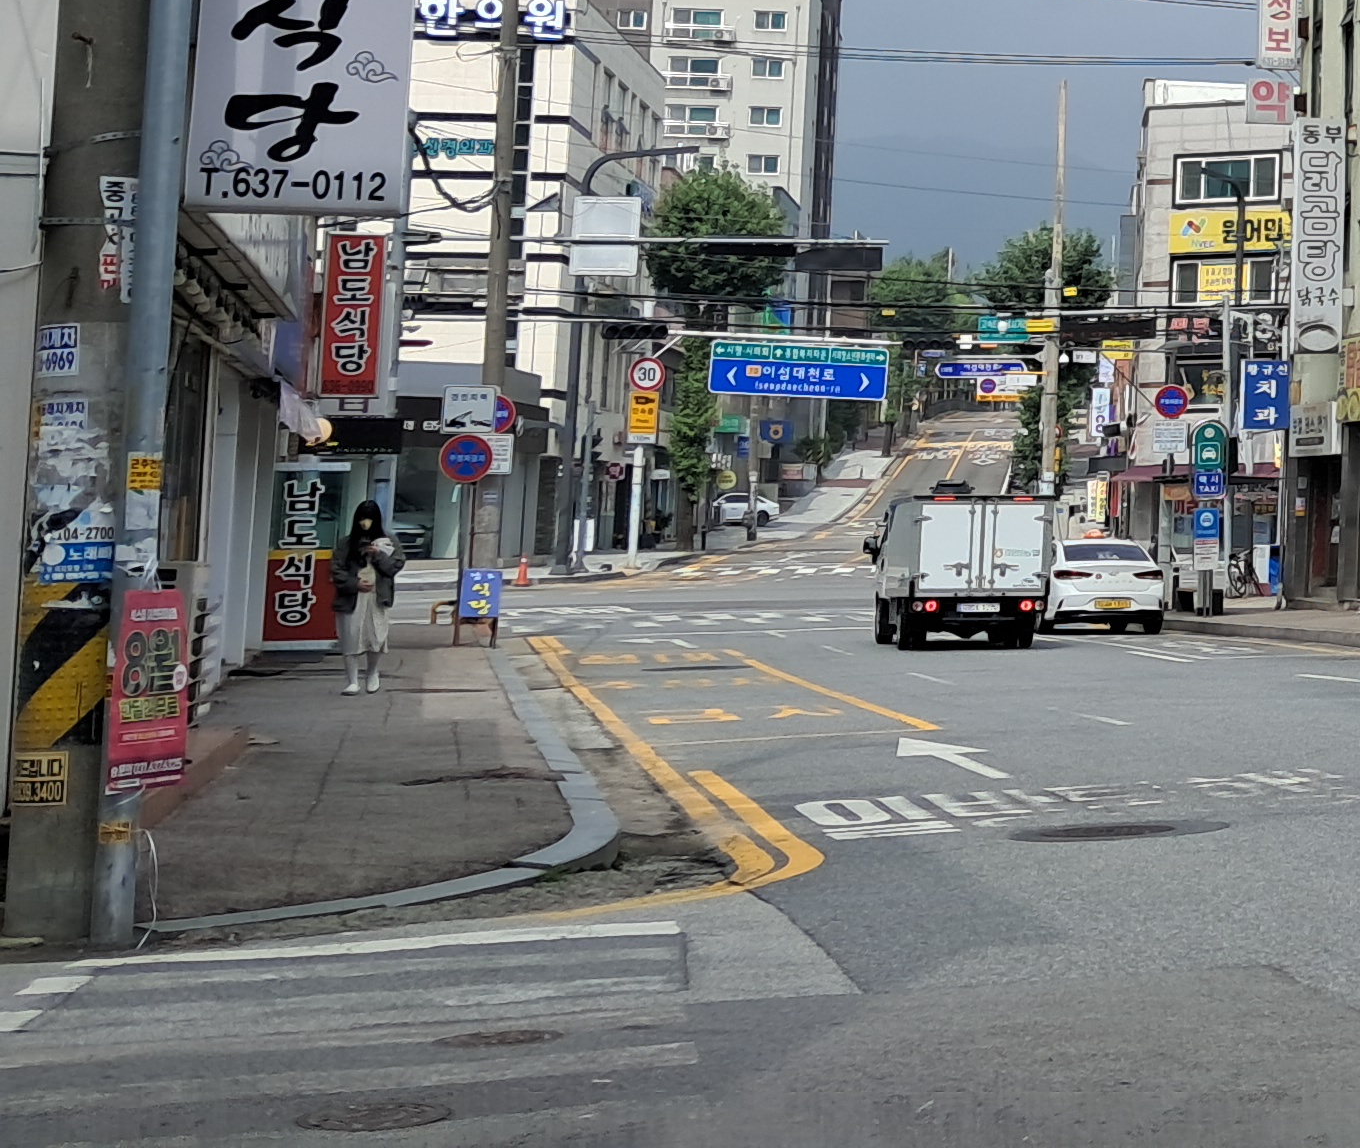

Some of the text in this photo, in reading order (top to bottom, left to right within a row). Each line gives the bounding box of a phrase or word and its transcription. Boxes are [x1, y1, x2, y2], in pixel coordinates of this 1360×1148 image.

[1252, 81, 1290, 122] 약
[1302, 125, 1342, 144] 동부
[200, 167, 387, 202] T.637-0112
[1299, 151, 1342, 282] 닭곰탕
[331, 240, 377, 375] 남도식당
[1297, 287, 1339, 306] 닭국수
[638, 367, 656, 382] 30
[763, 365, 836, 382] 이섭대천로
[1253, 379, 1279, 426] 치과
[1199, 485, 1219, 493] TAXI
[275, 478, 325, 626] 남도식당
